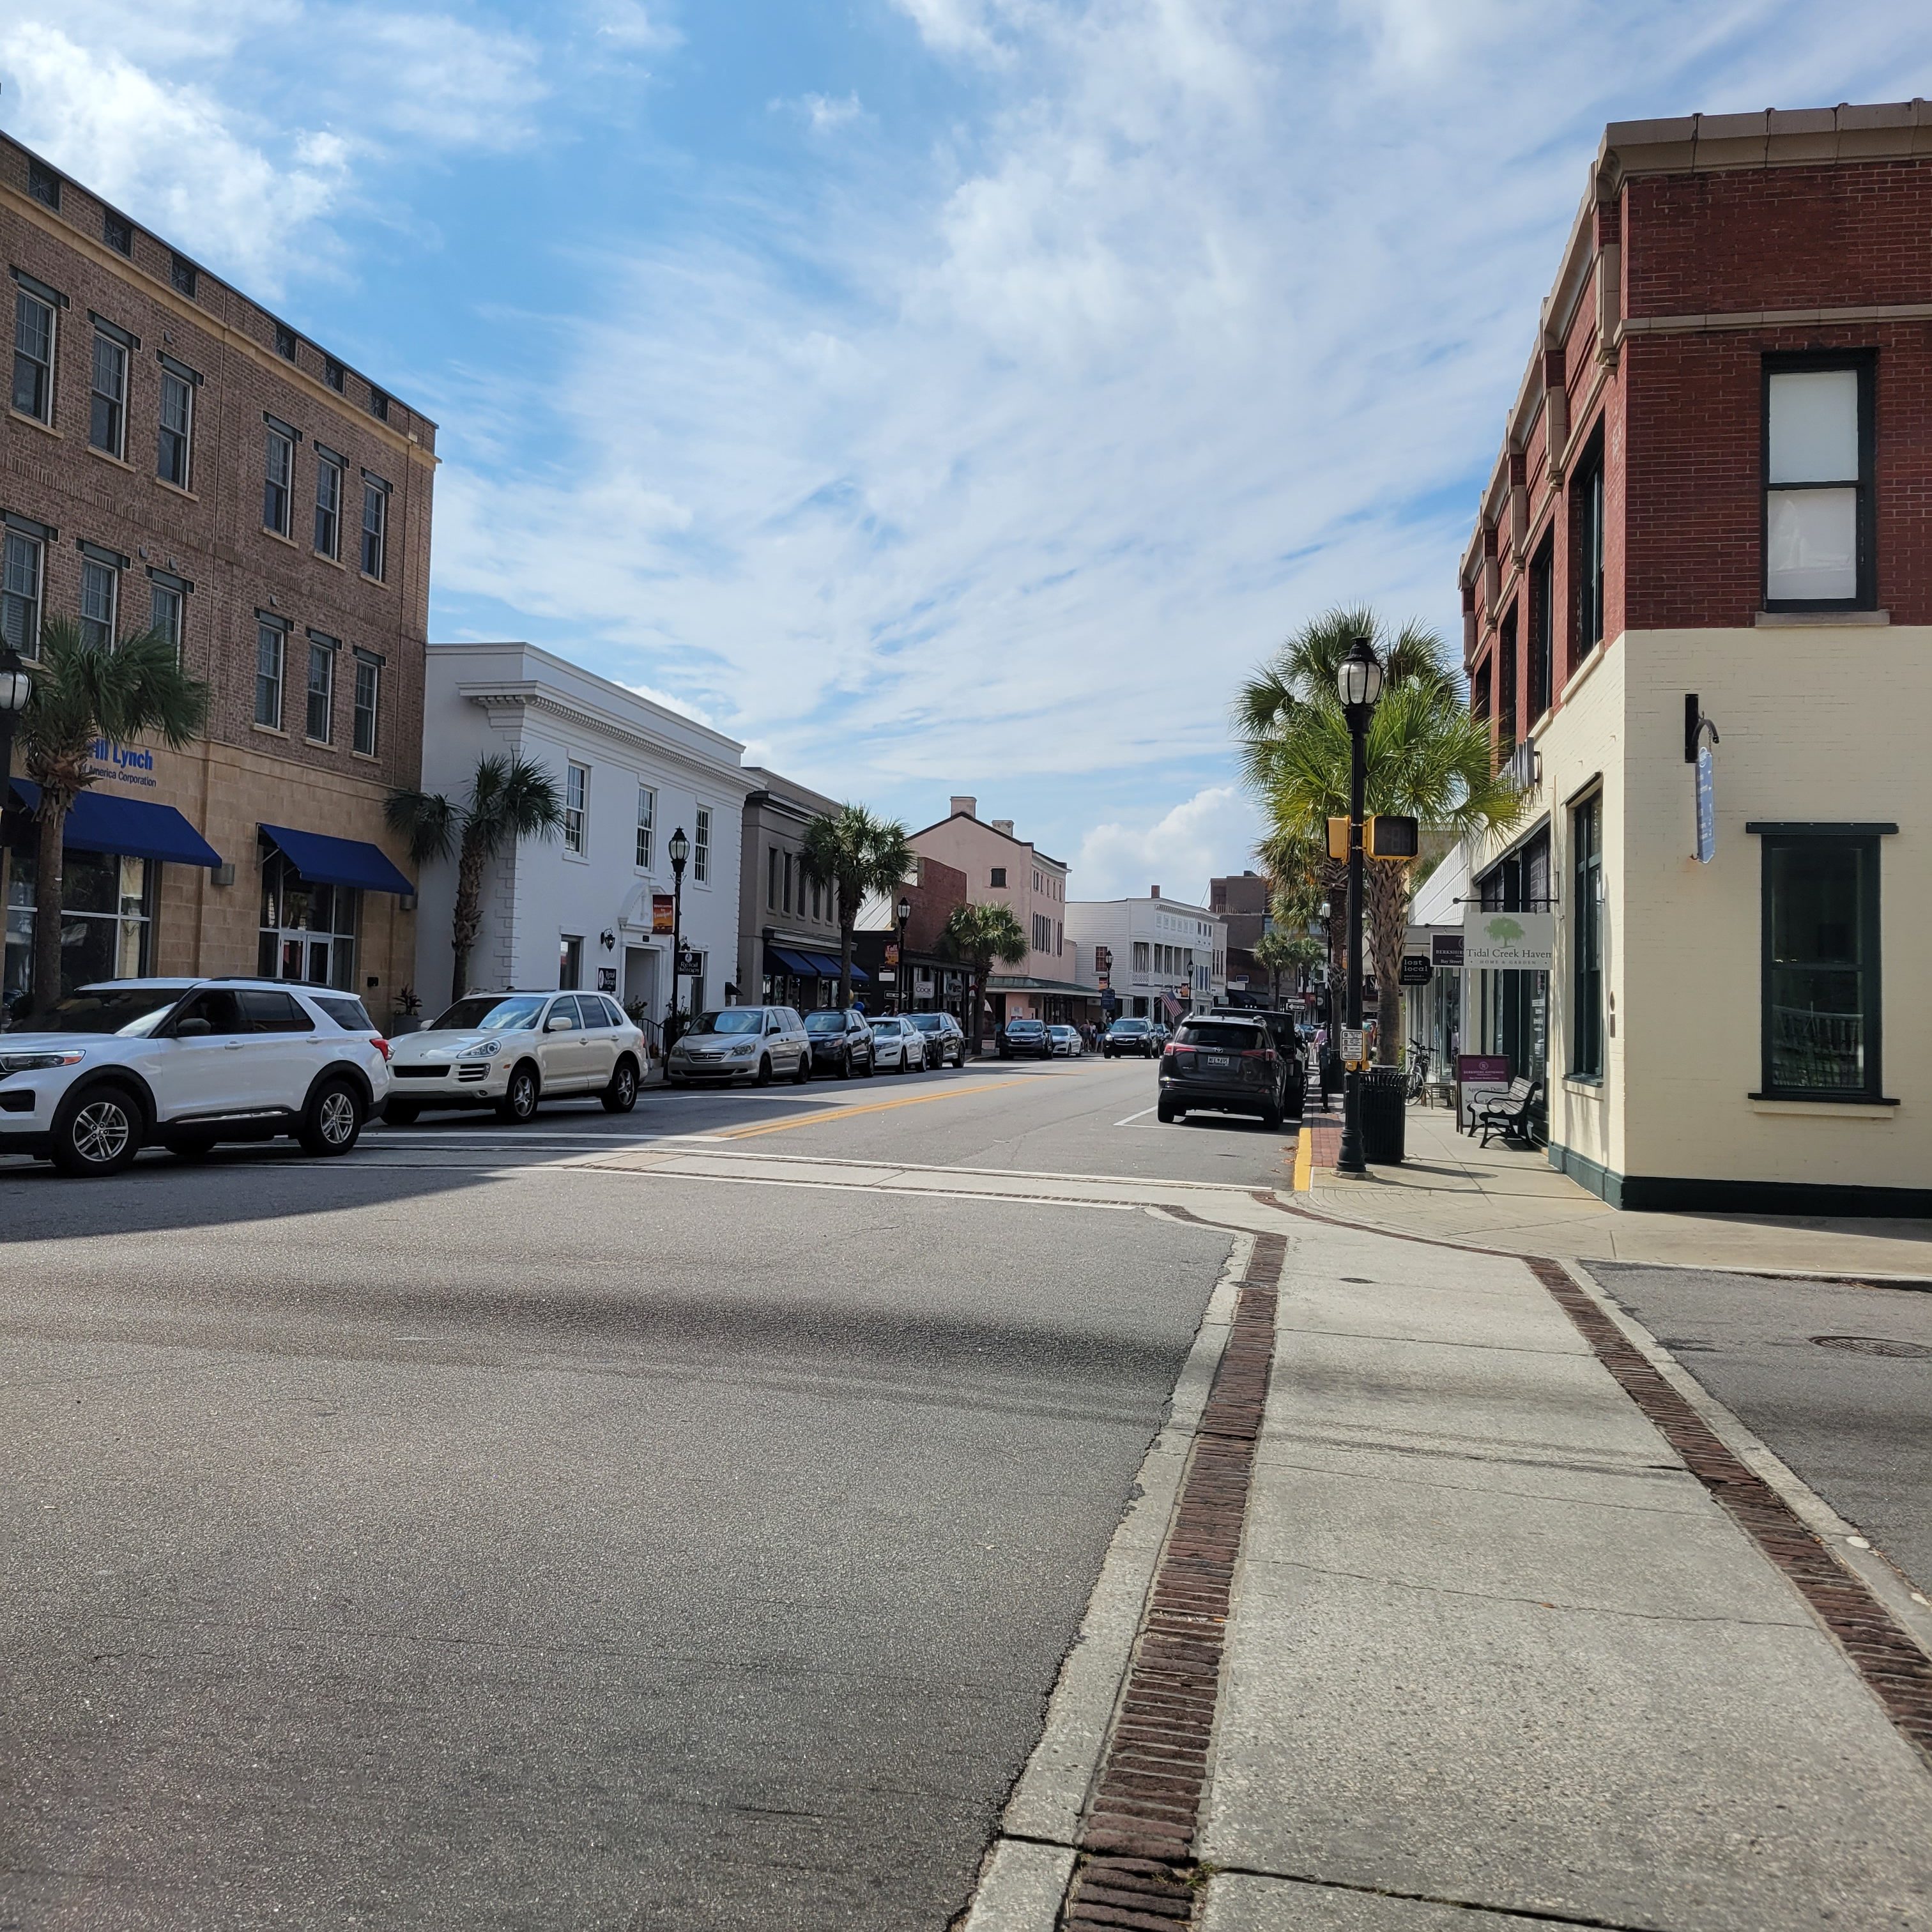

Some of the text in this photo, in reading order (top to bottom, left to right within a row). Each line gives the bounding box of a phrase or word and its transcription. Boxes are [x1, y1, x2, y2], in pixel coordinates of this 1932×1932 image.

[113, 743, 153, 770] Lynch
[89, 765, 116, 779] America
[118, 771, 157, 787] Corporation
[1466, 948, 1552, 958] Tidal Creek Haven
